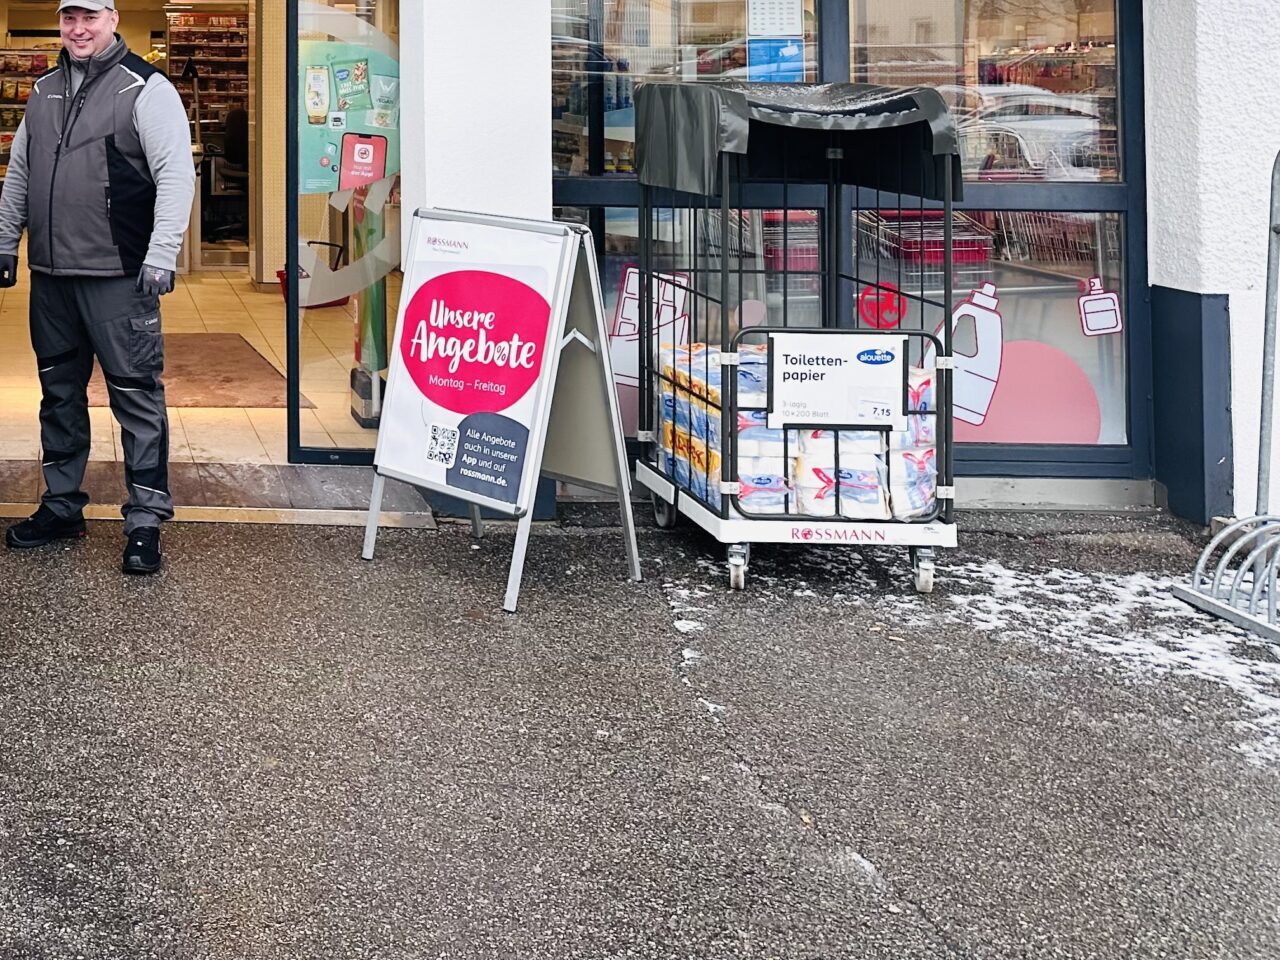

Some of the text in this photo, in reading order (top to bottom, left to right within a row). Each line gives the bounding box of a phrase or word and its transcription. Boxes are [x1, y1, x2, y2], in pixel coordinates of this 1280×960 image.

[427, 236, 469, 249] ROSSMANN
[429, 299, 496, 330] Unsere
[410, 320, 536, 374] Angebote
[783, 354, 848, 366] Toiletten-
[429, 375, 464, 391] Montag
[474, 380, 506, 395] Freitag
[783, 370, 826, 383] papier
[466, 428, 516, 449] Alle Angebote
[464, 442, 518, 463] auch in unserer
[462, 453, 507, 473] App und auf
[460, 467, 508, 487] rossmann.de.
[791, 527, 886, 541] ROSSMANN
